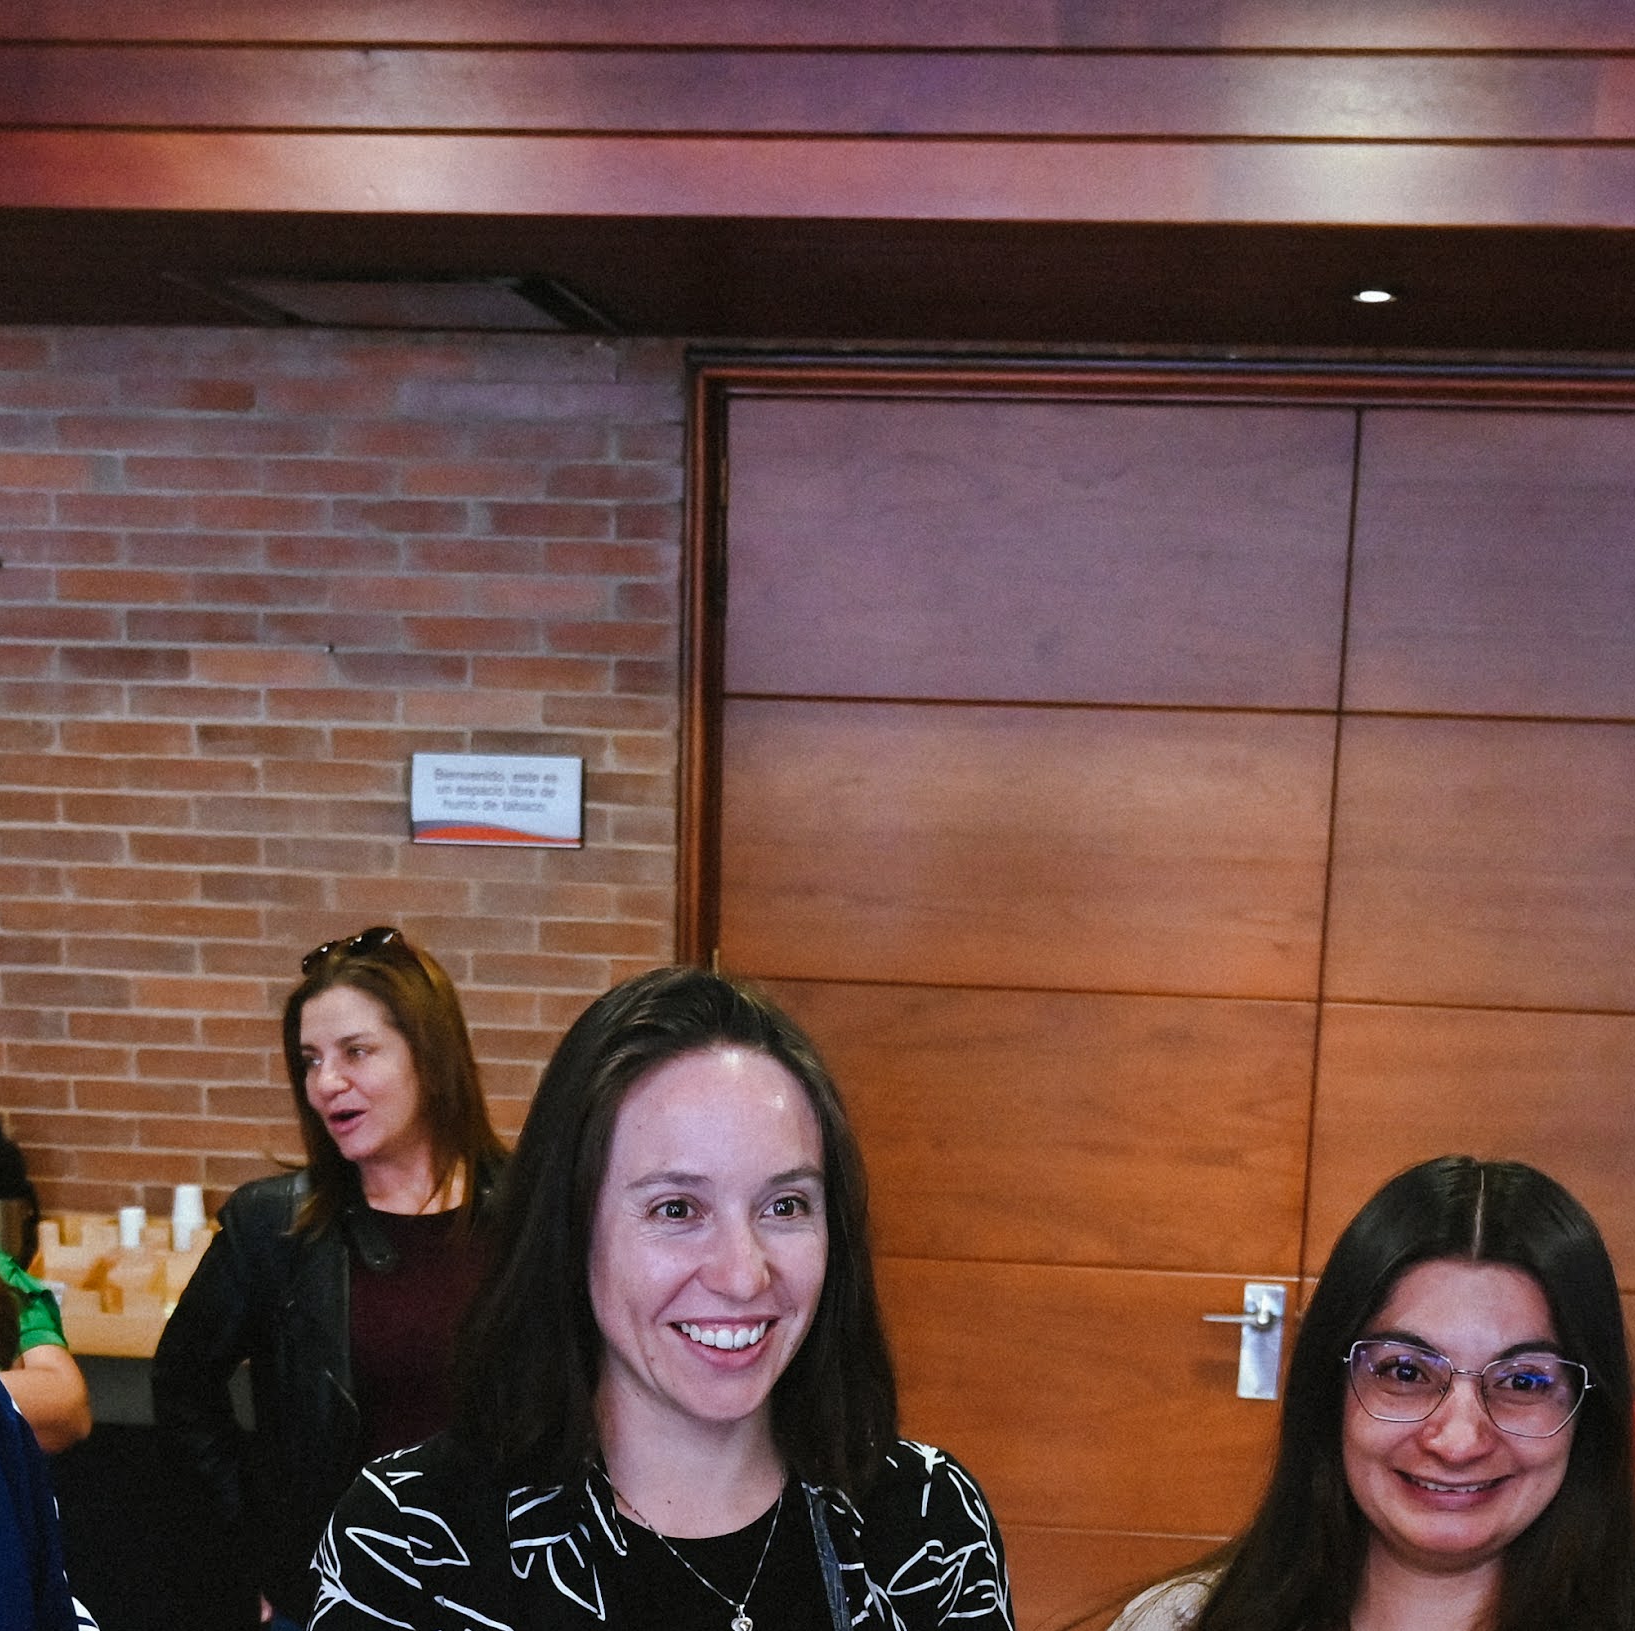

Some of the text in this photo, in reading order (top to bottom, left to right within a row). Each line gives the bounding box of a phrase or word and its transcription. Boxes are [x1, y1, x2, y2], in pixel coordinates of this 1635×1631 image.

[543, 774, 558, 784] es
[436, 785, 556, 799] un espacio libre de
[483, 800, 498, 811] de
